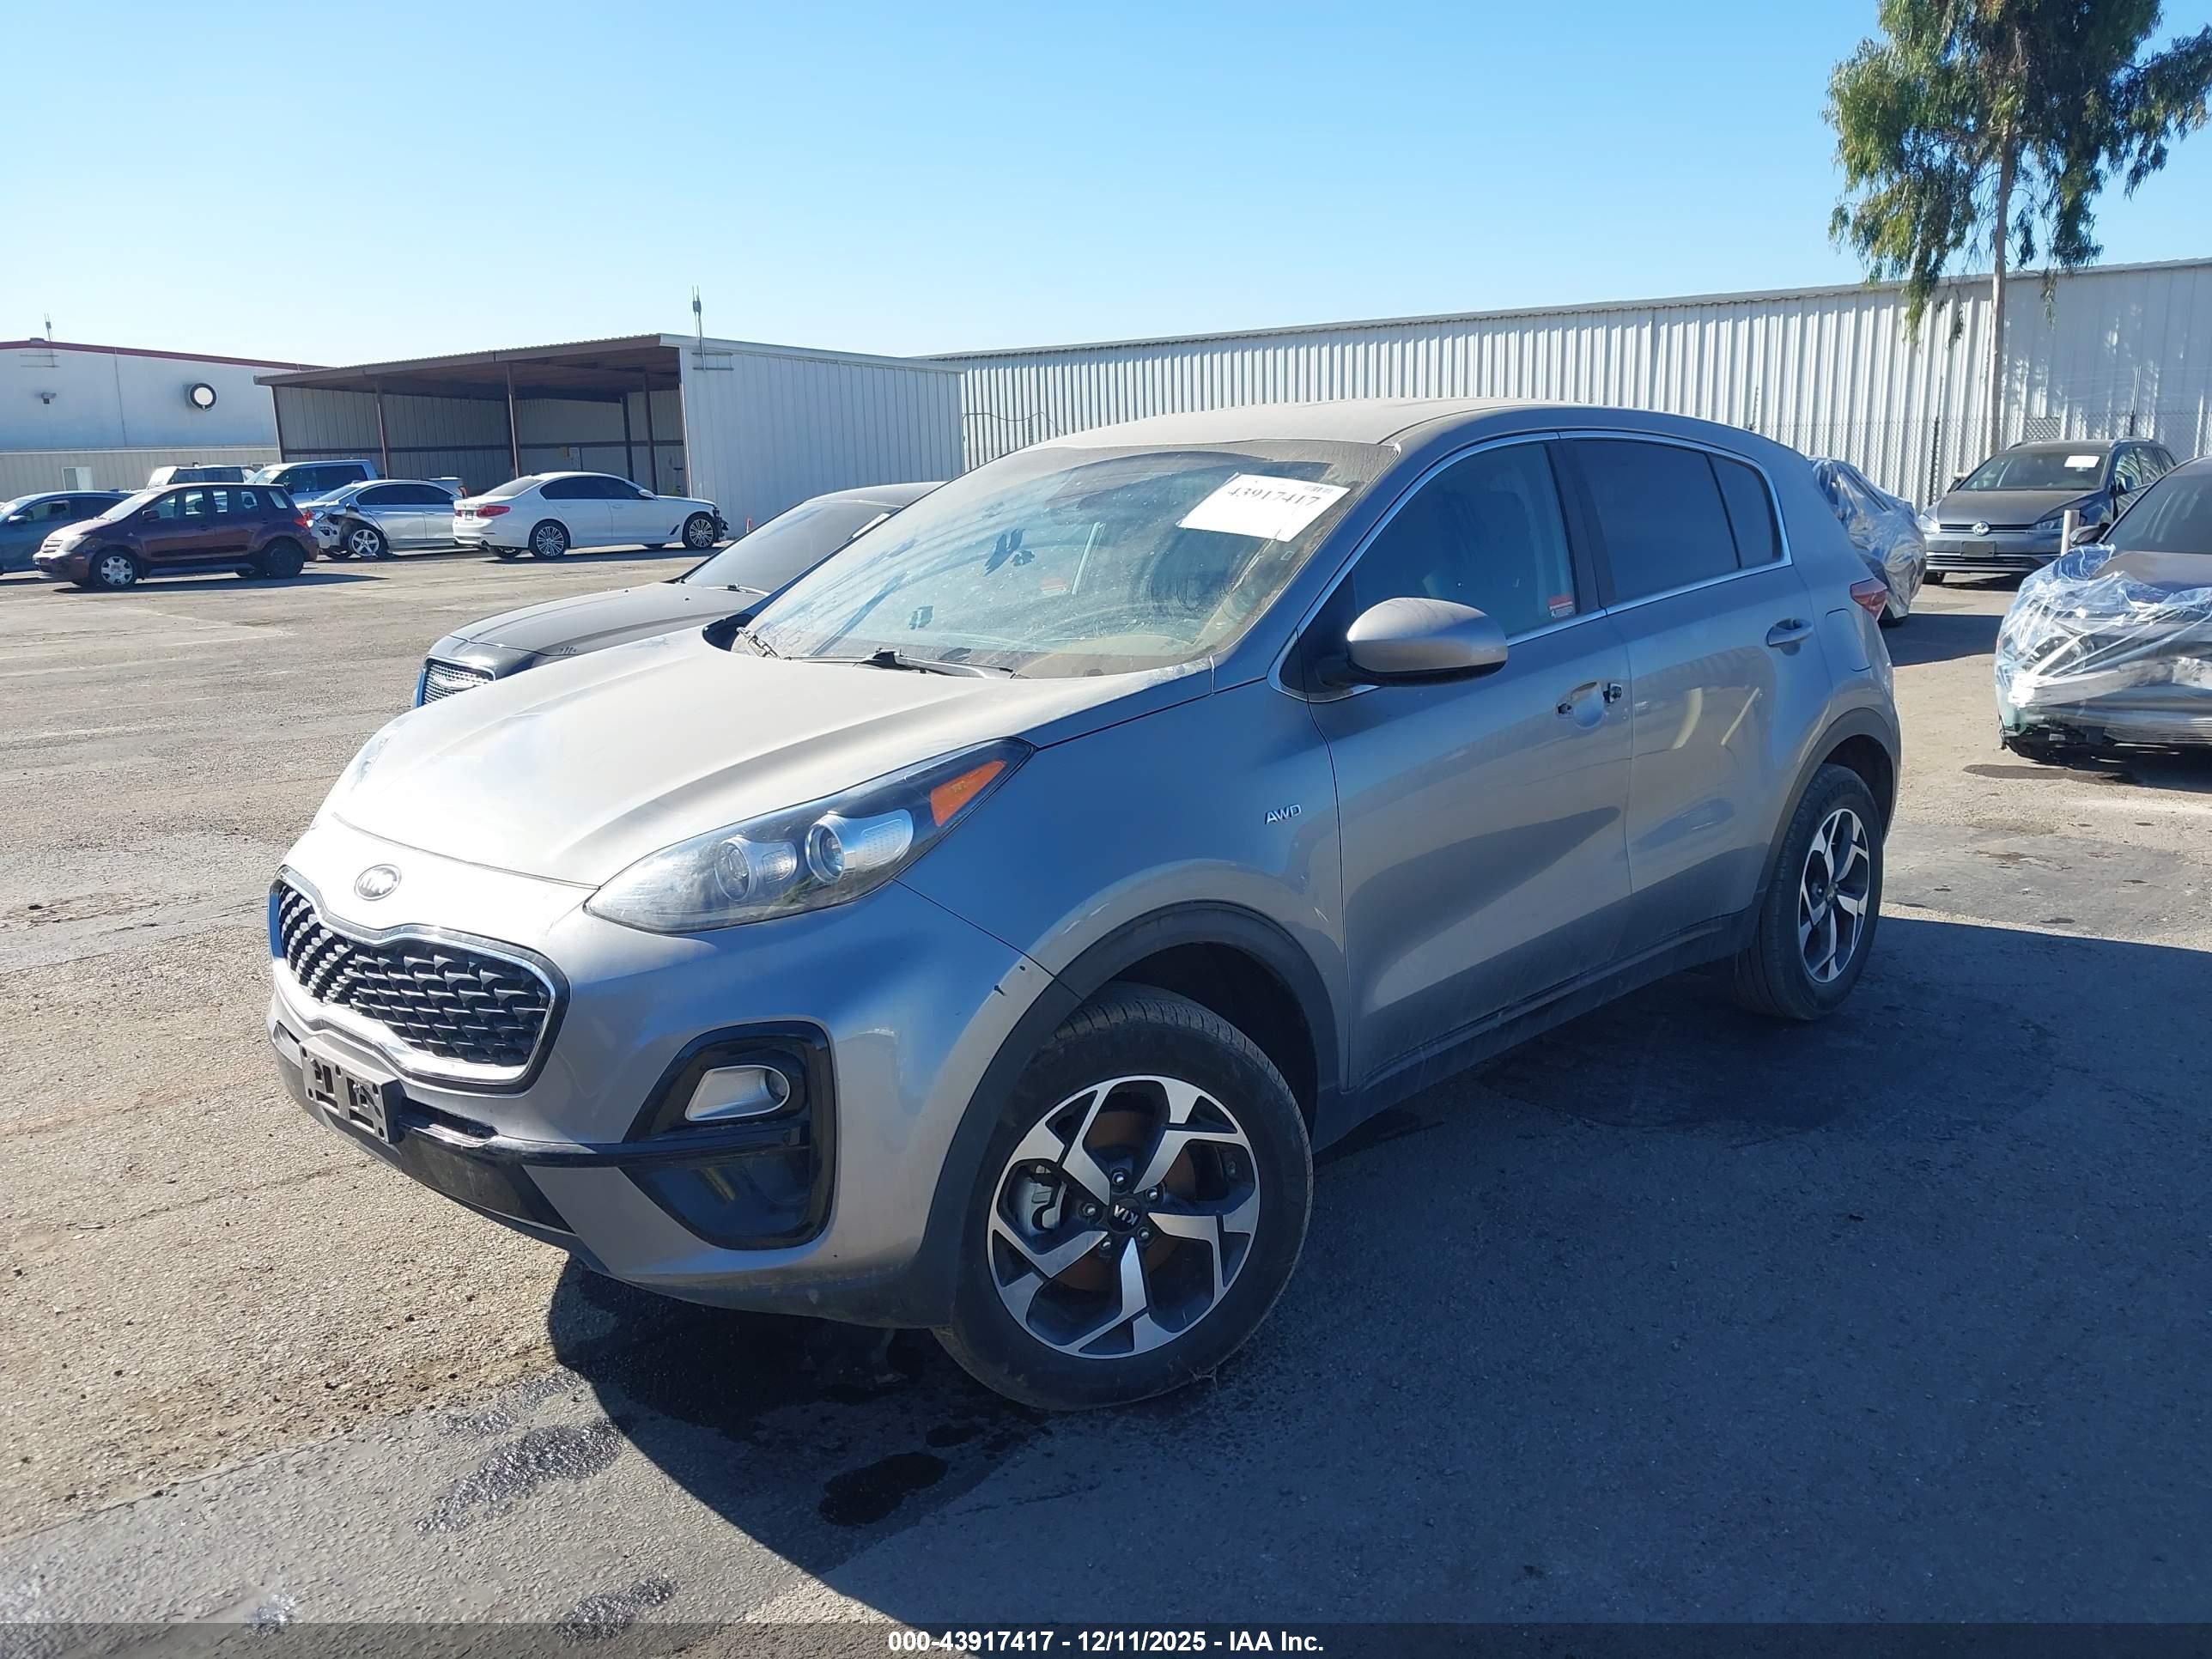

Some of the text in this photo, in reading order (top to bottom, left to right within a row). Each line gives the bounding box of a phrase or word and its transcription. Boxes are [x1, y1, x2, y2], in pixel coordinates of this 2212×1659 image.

[1229, 486, 1321, 506] 43917417
[1265, 804, 1302, 825] AWD
[1114, 1204, 1139, 1225] KIA
